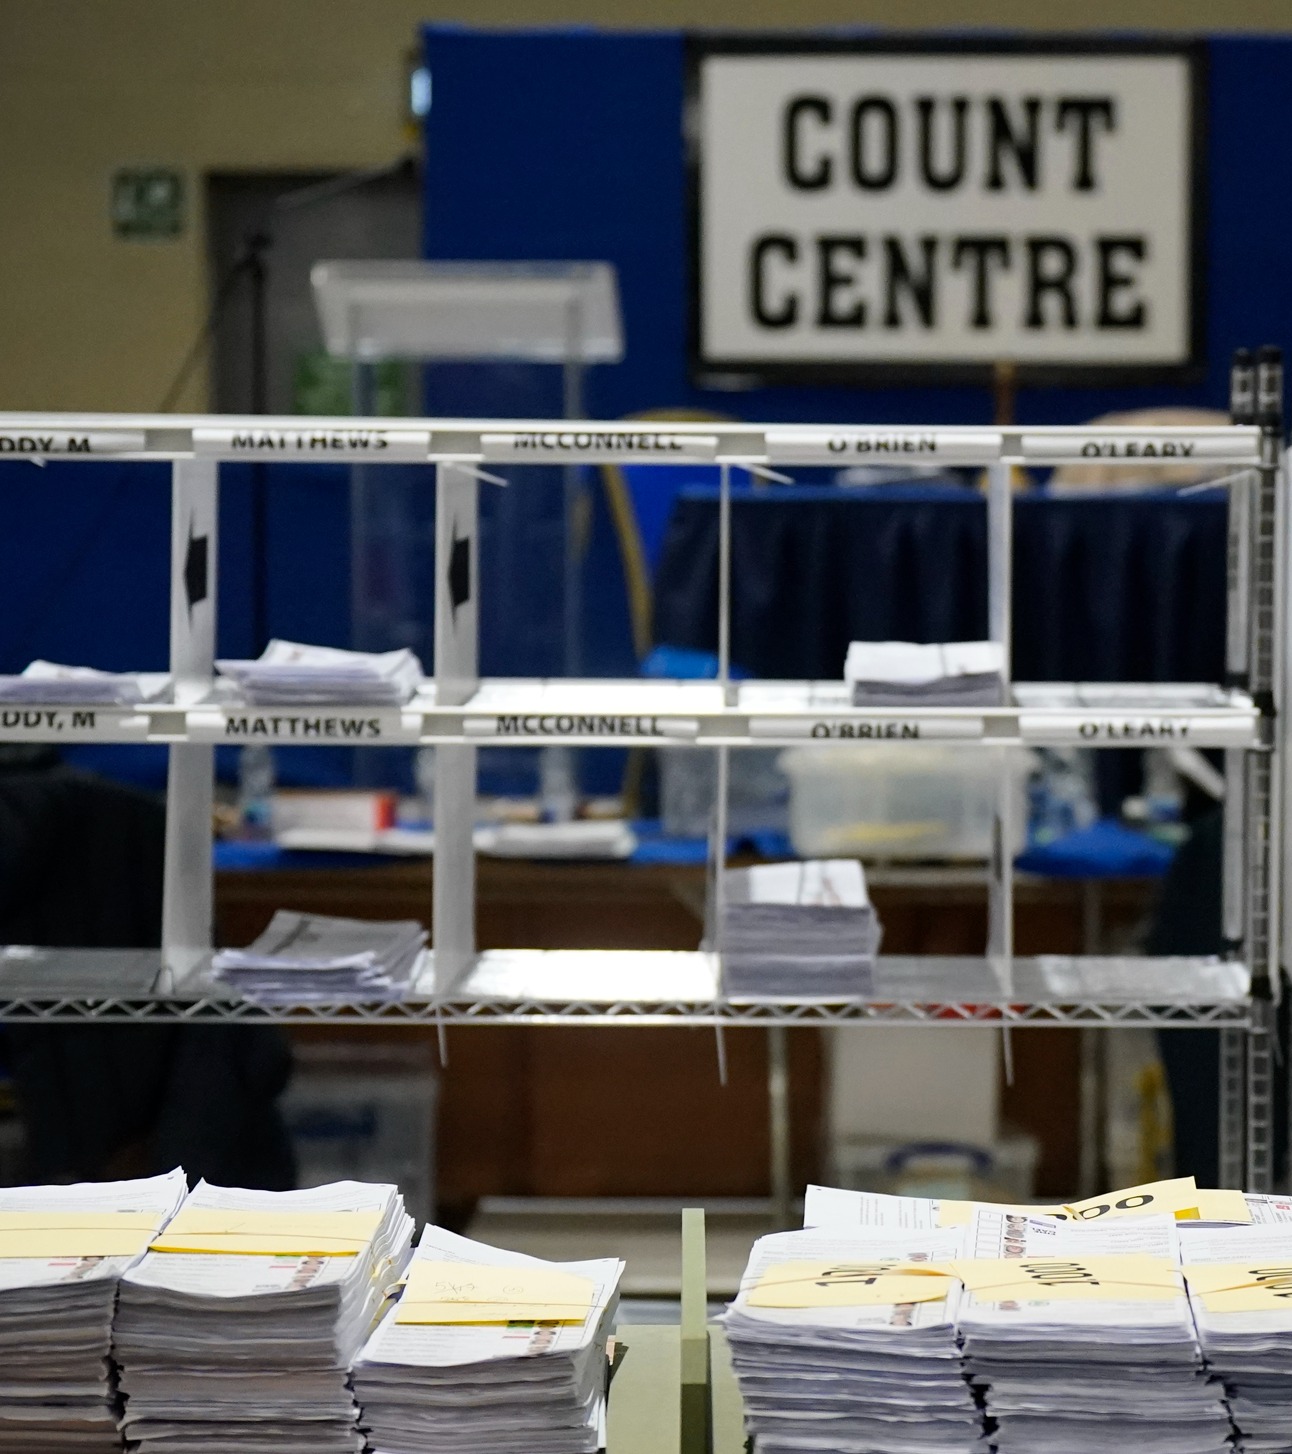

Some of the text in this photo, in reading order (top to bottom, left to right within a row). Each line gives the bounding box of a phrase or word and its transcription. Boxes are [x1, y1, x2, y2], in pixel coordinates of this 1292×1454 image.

[783, 93, 1119, 193] COUNT
[746, 231, 1149, 331] CENTRE
[67, 437, 90, 452] M
[230, 430, 388, 450] MATTHEWS
[513, 432, 683, 450] MCCONNELL
[72, 711, 95, 728] M
[225, 716, 382, 737] MATTHEWS
[496, 714, 664, 736] MCCONNELL
[810, 721, 920, 739] O'BRIEN
[1019, 1262, 1101, 1286] 1000
